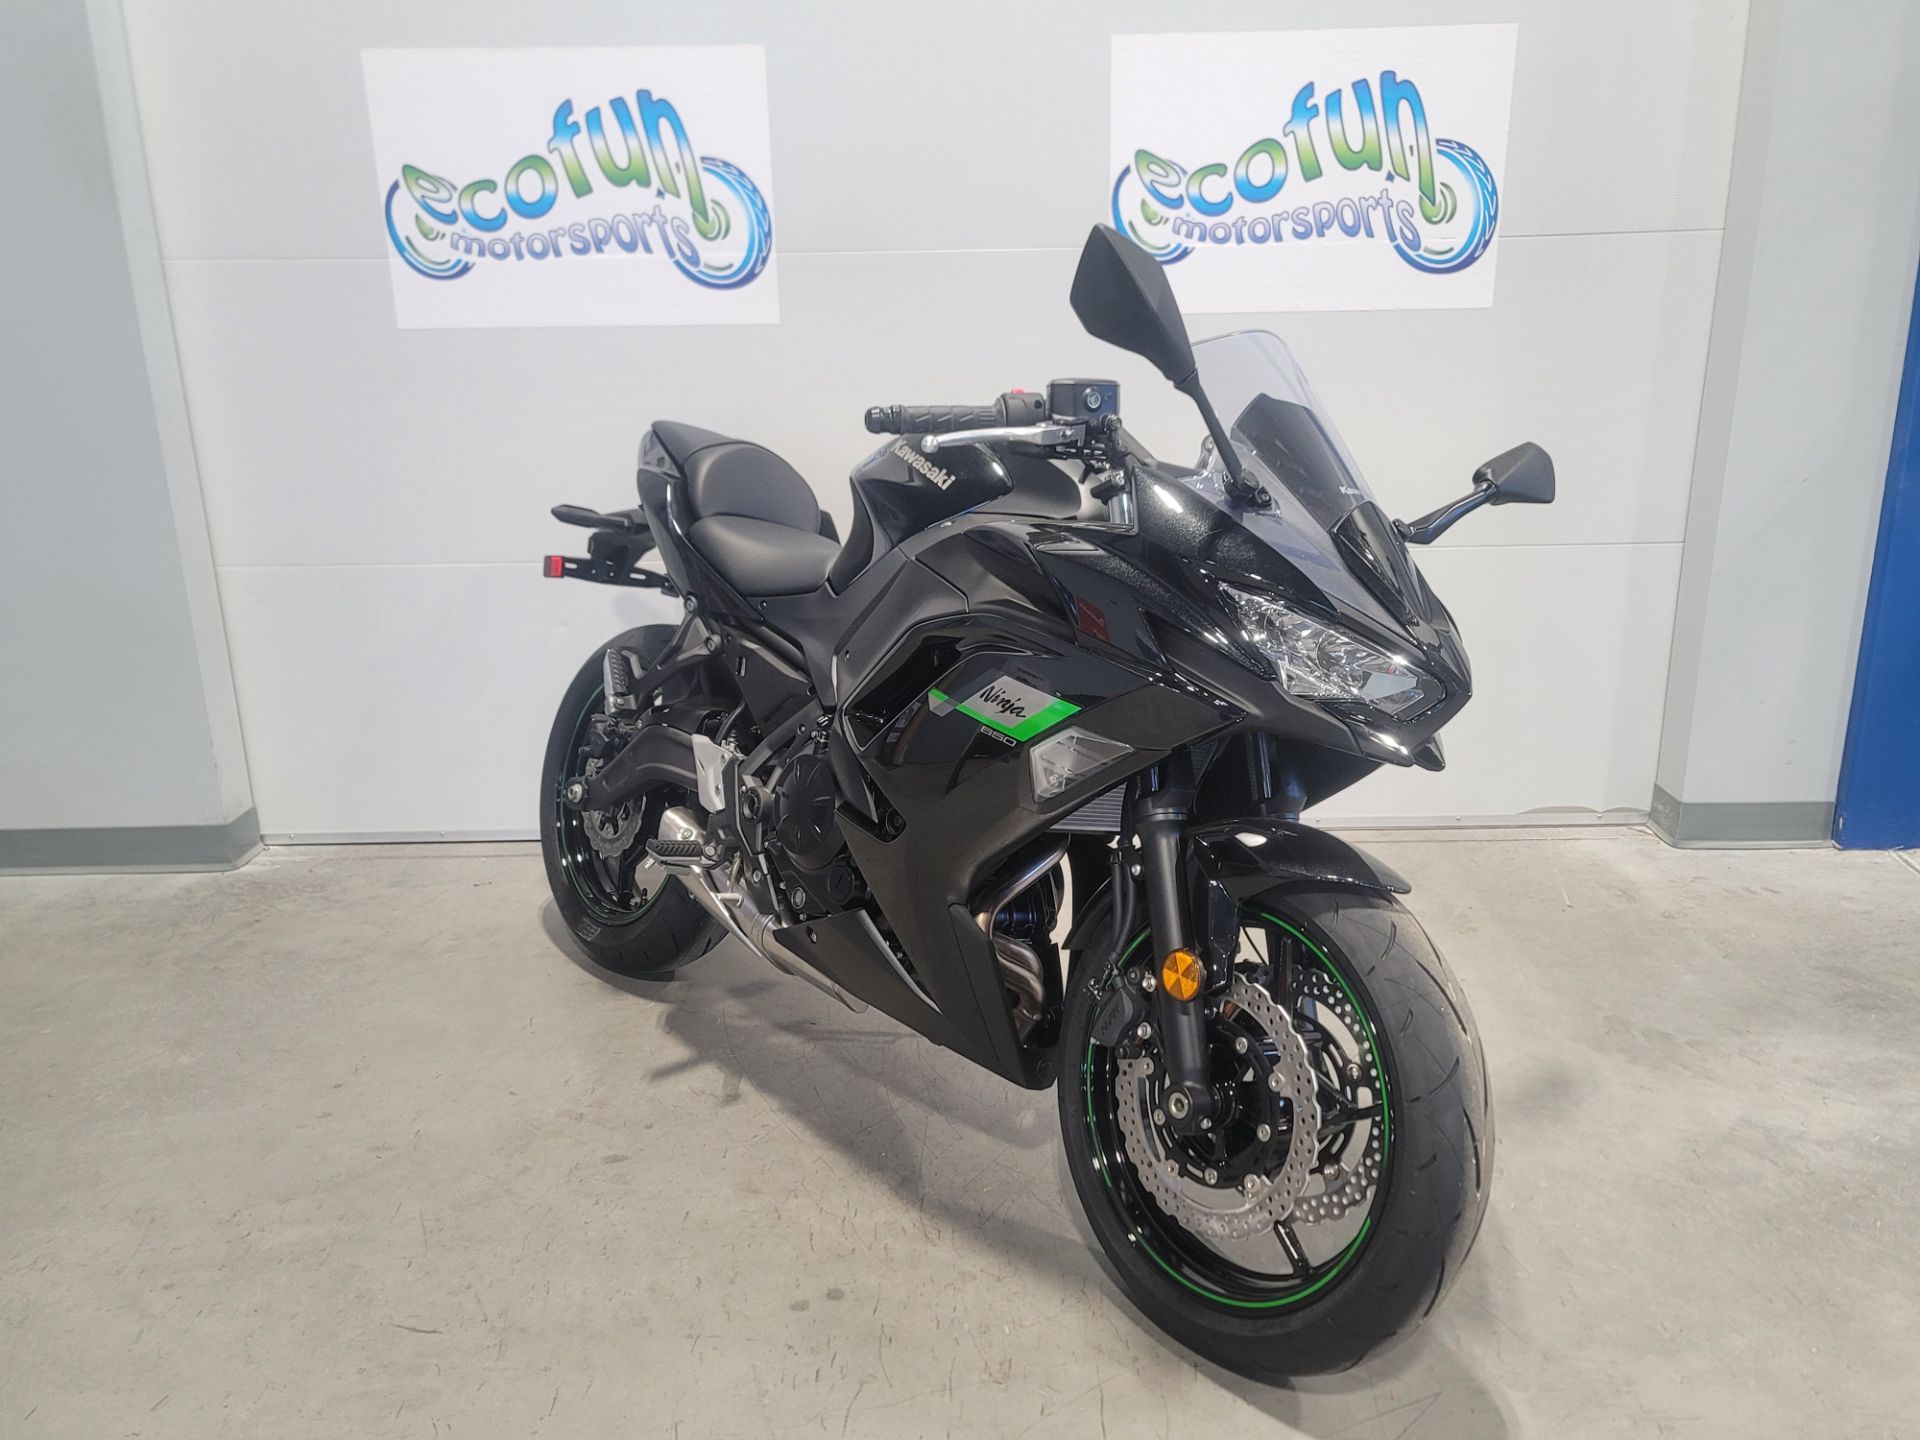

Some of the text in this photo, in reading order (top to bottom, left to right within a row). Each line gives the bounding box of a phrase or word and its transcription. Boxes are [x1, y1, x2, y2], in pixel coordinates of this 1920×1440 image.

[402, 89, 711, 231] ecofun
[1135, 70, 1436, 217] ecofun
[451, 205, 701, 268] motorsports
[1172, 188, 1421, 252] motorsports
[891, 437, 956, 490] Kawasaki
[979, 685, 1026, 718] Ninja
[980, 725, 1017, 747] 650
